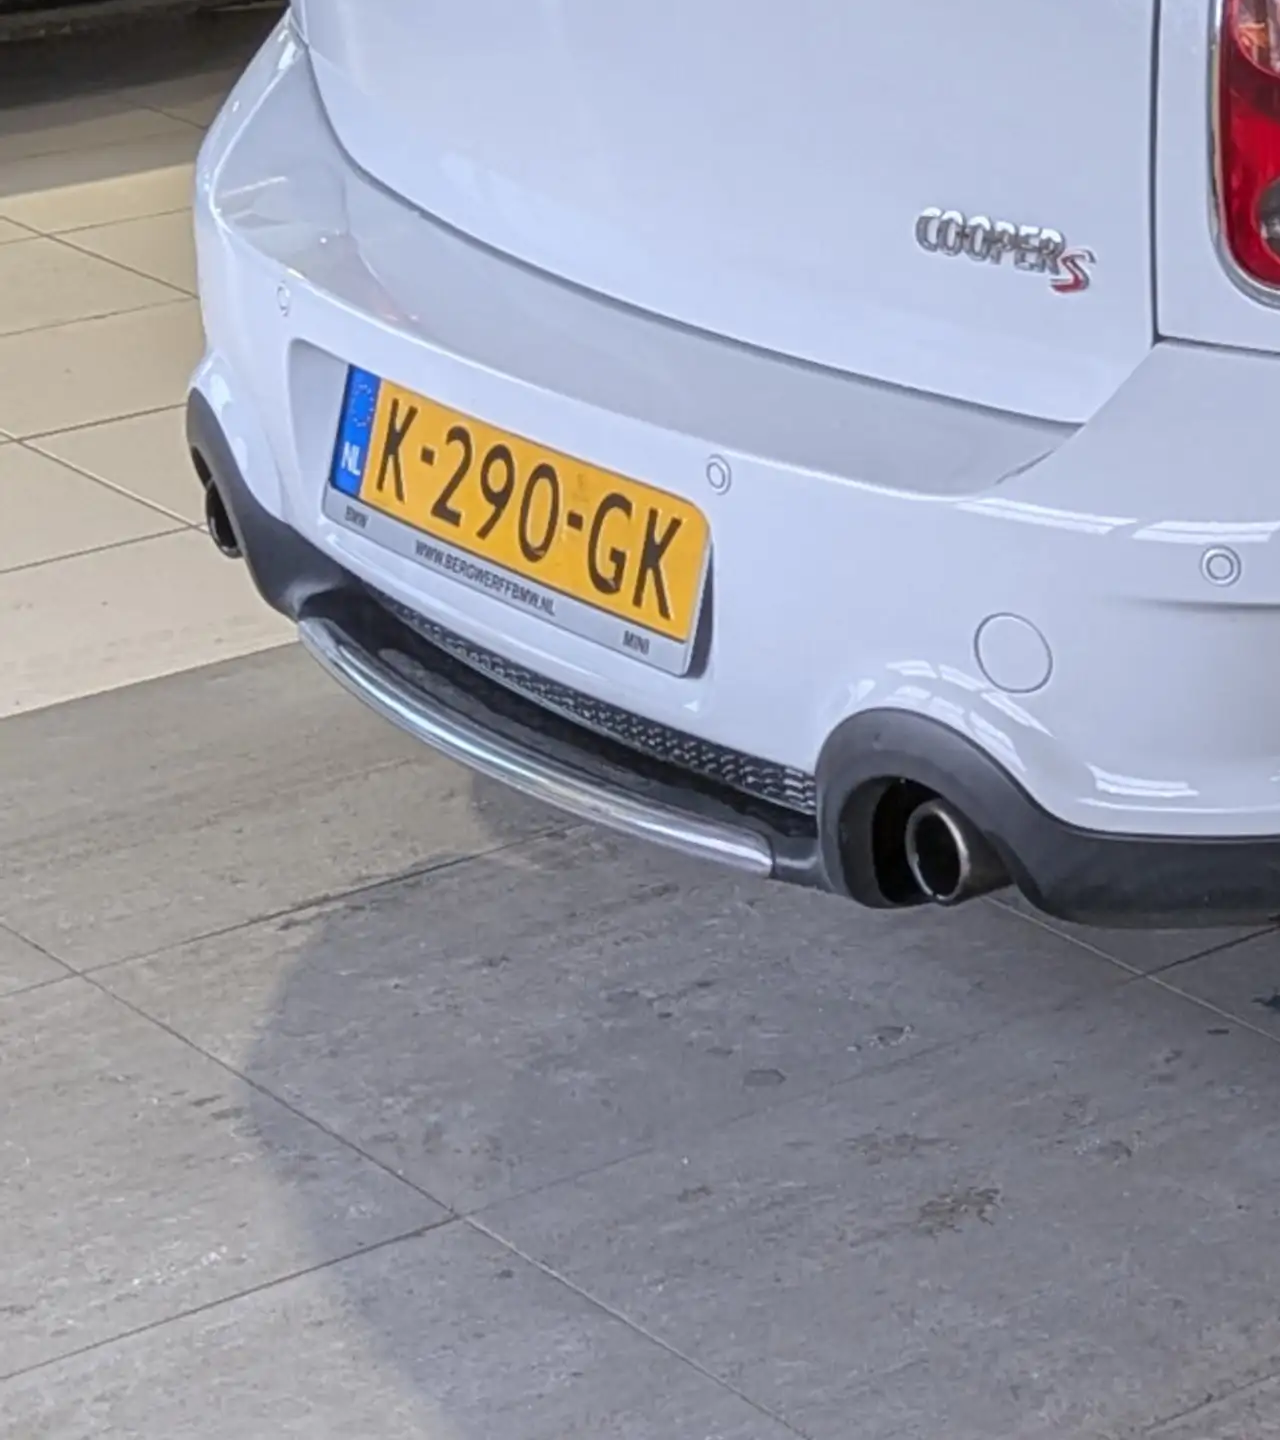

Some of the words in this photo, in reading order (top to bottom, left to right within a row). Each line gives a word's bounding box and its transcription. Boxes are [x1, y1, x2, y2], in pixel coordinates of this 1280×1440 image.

[915, 206, 1067, 277] COOPER
[1048, 244, 1098, 294] S
[340, 440, 362, 477] NL
[375, 397, 684, 621] K-290-GK
[621, 628, 651, 656] MINI
